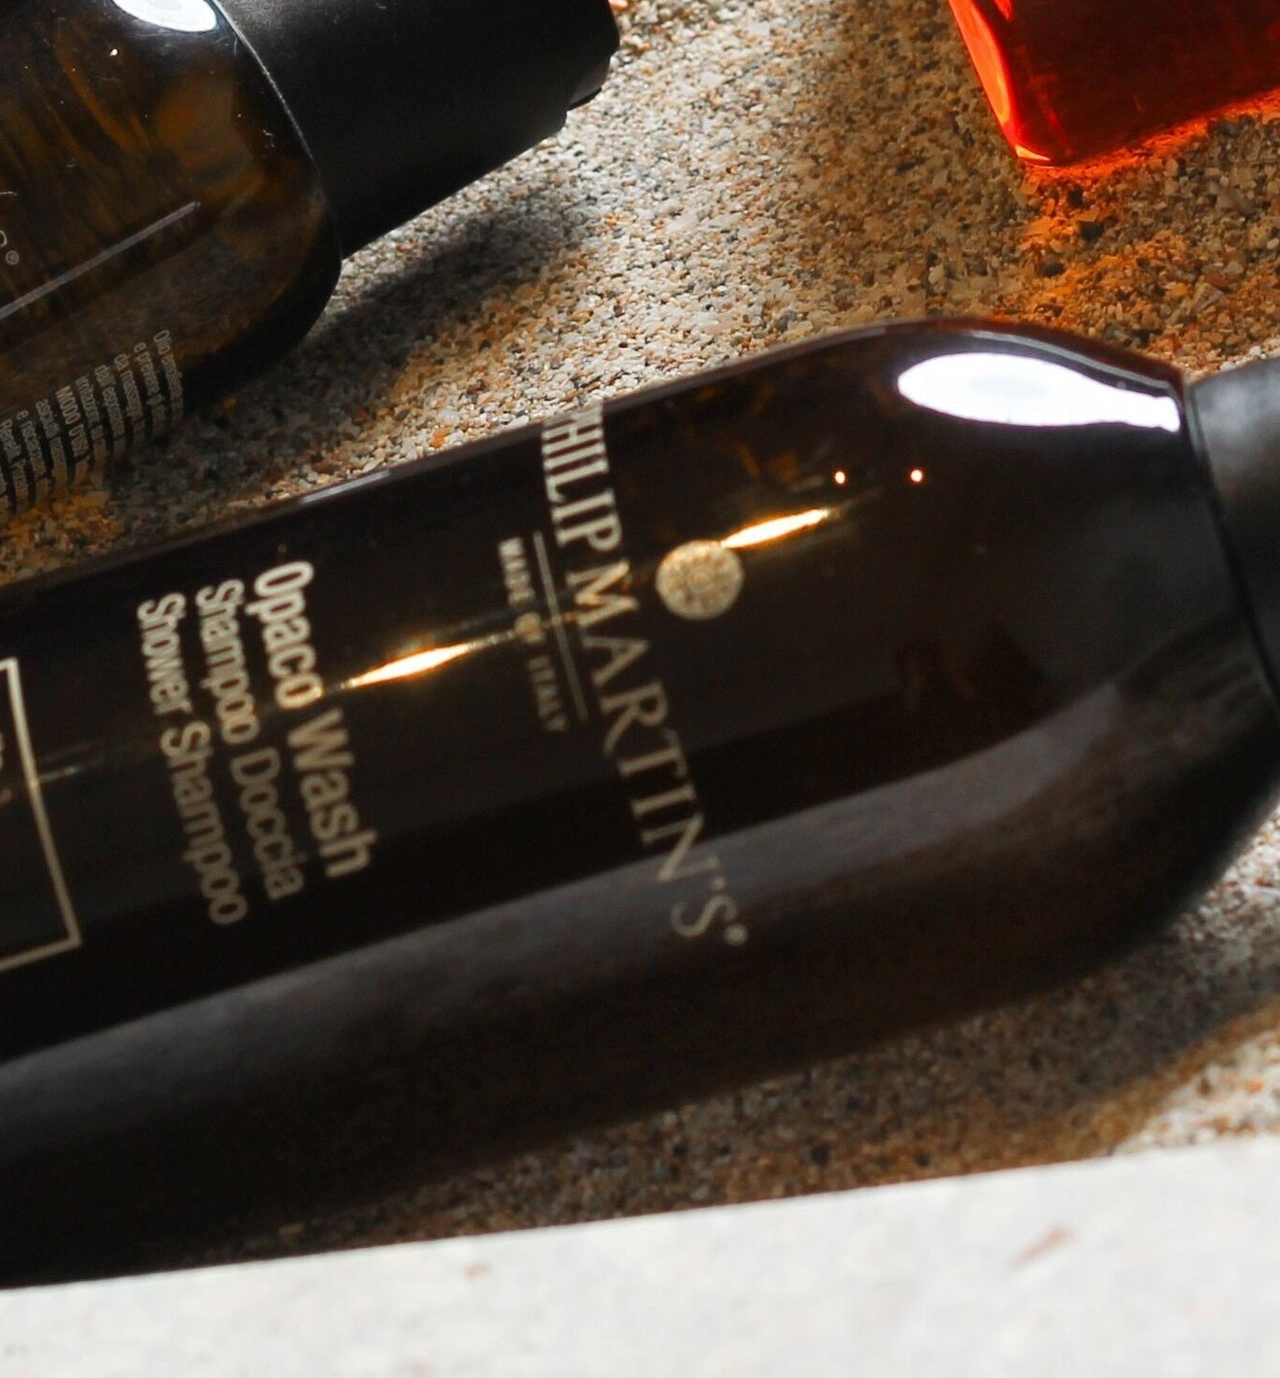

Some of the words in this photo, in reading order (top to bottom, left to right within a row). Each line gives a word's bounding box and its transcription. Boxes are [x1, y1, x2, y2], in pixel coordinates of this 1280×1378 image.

[55, 383, 80, 427] MODO
[112, 349, 132, 372] da
[137, 592, 192, 714] Shower
[246, 561, 322, 709] Opaco
[287, 708, 375, 875] Wash
[195, 579, 259, 744] Shampoo
[229, 746, 306, 899] Doccia
[159, 720, 246, 923] Shampoo
